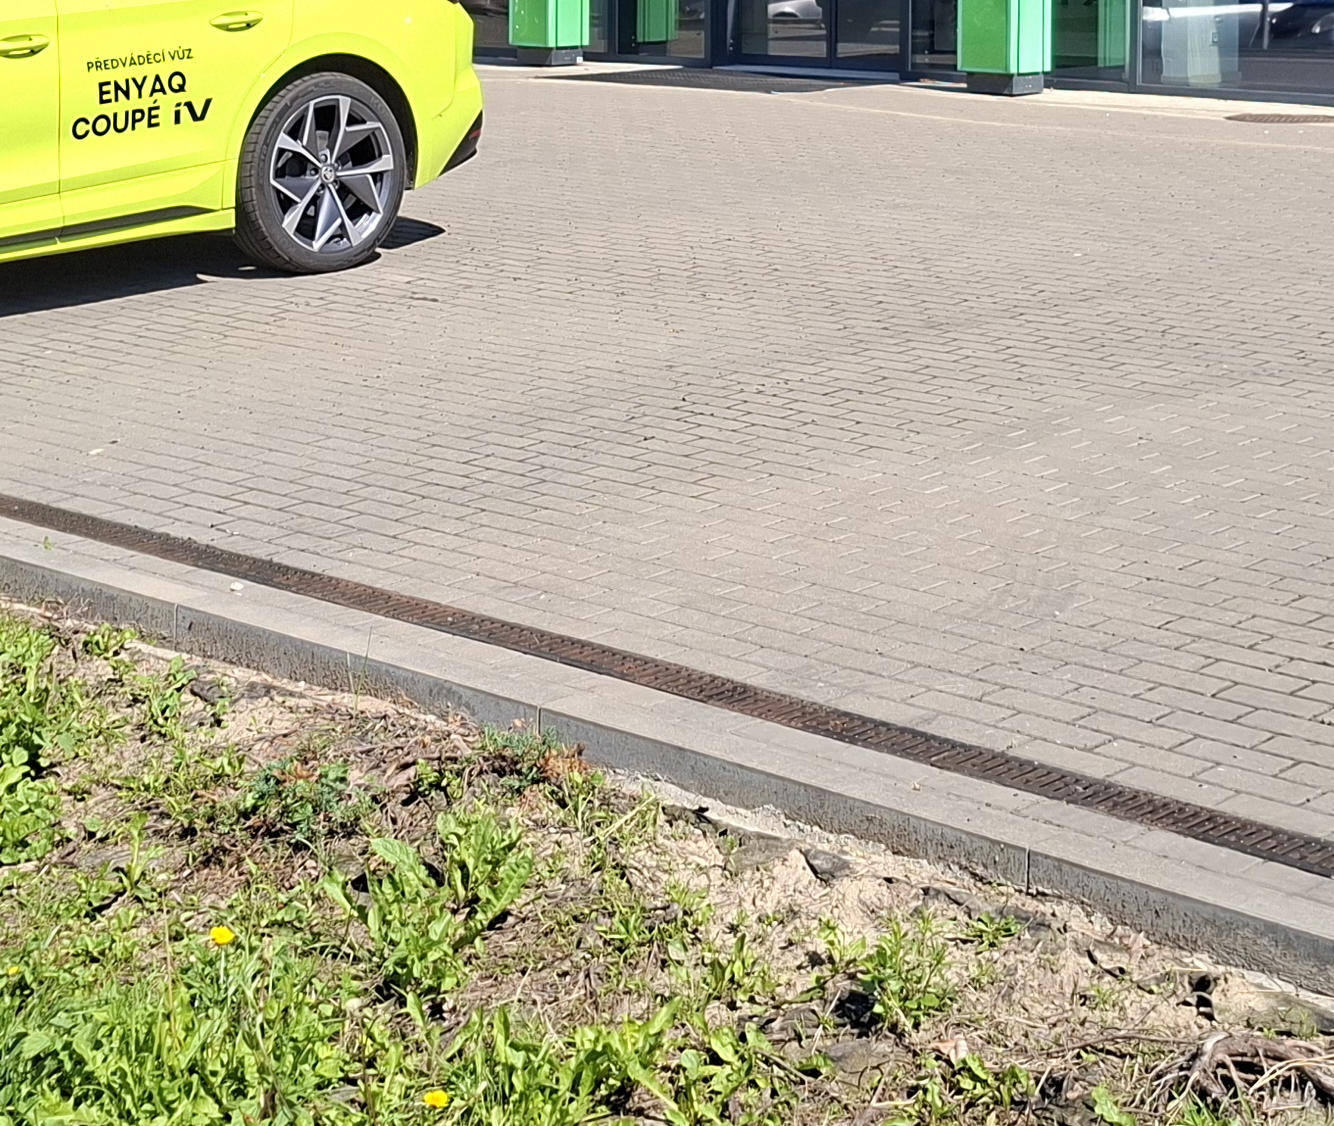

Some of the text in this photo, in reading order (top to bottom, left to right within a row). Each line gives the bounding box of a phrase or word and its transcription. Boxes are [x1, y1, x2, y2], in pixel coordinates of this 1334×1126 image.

[86, 45, 194, 73] PŘEDVÁDĚCÍ VŮZ
[98, 71, 187, 105] ENYAQ
[71, 99, 161, 140] COUPÉ
